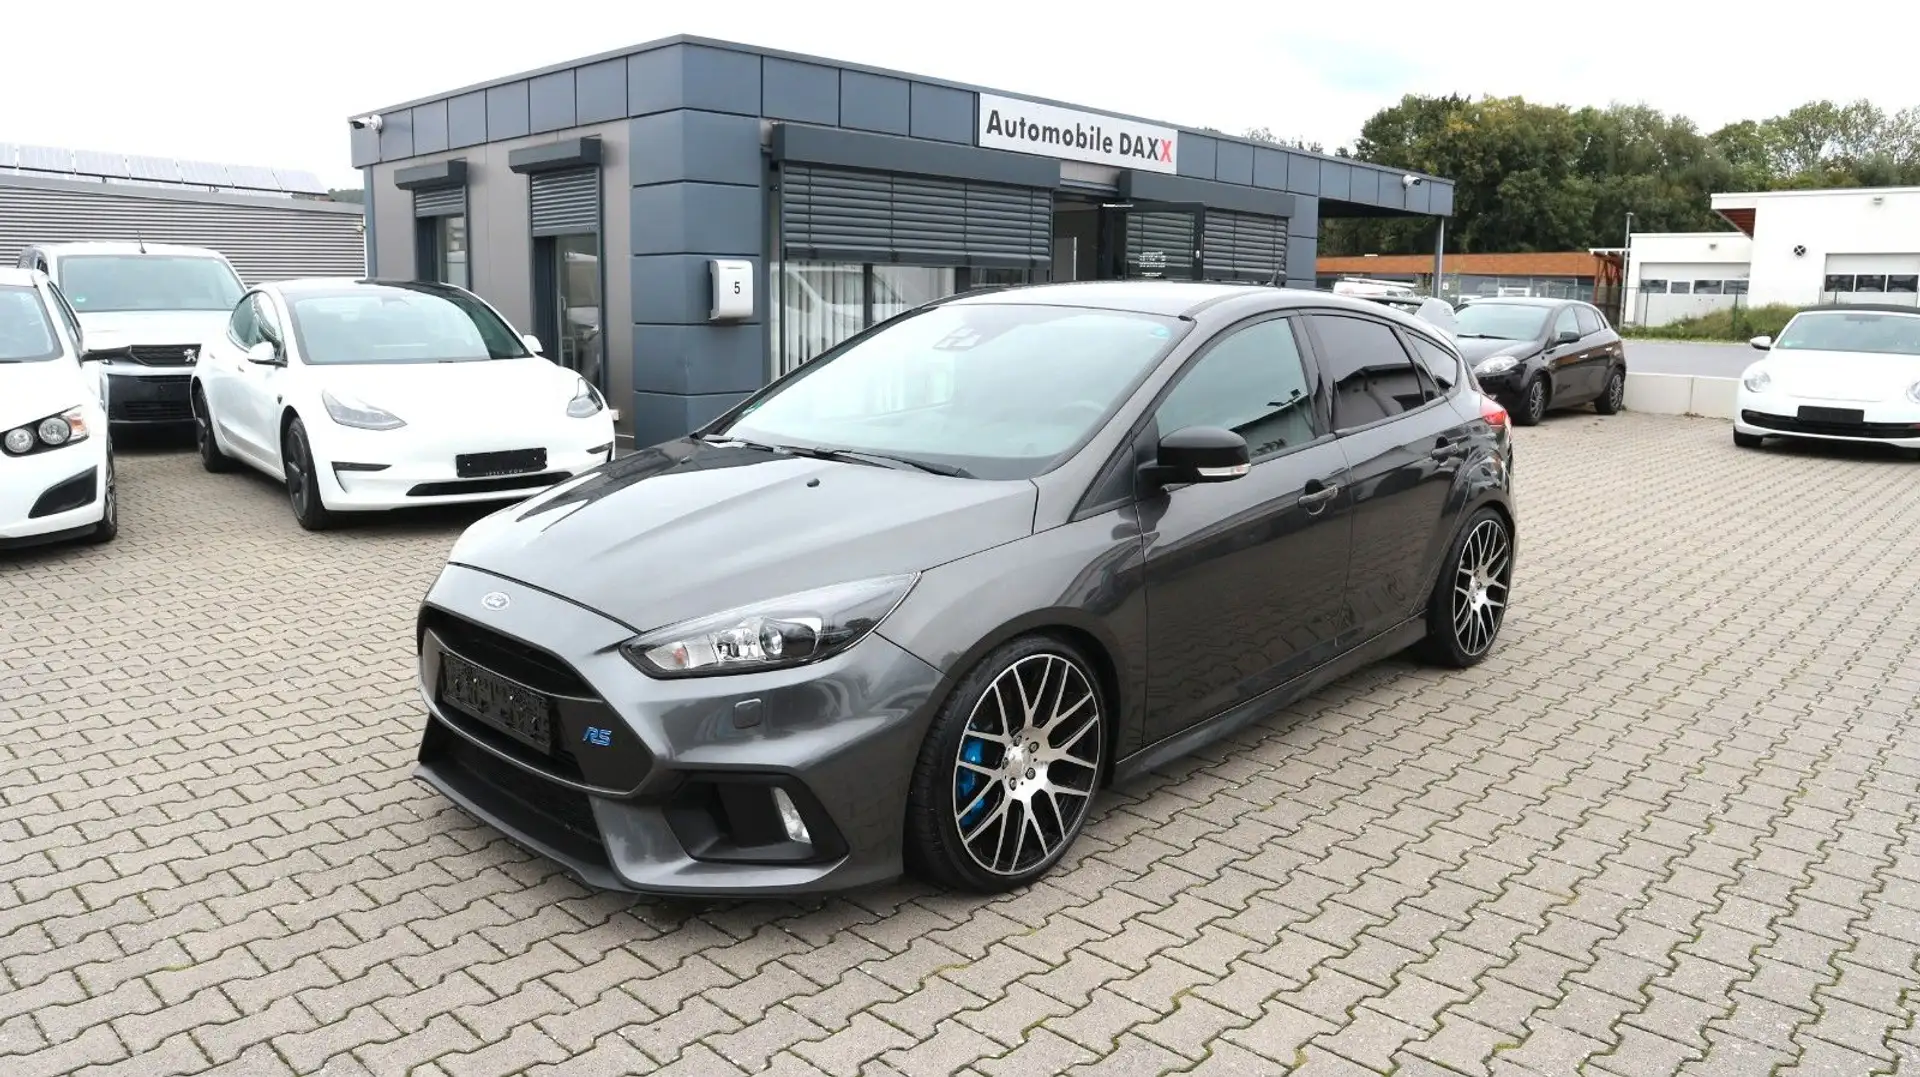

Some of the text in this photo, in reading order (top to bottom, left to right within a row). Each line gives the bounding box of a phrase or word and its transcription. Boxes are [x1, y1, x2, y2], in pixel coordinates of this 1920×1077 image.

[986, 109, 1173, 163] Automobile DAXX
[734, 280, 741, 295] 5
[583, 726, 612, 746] RS
